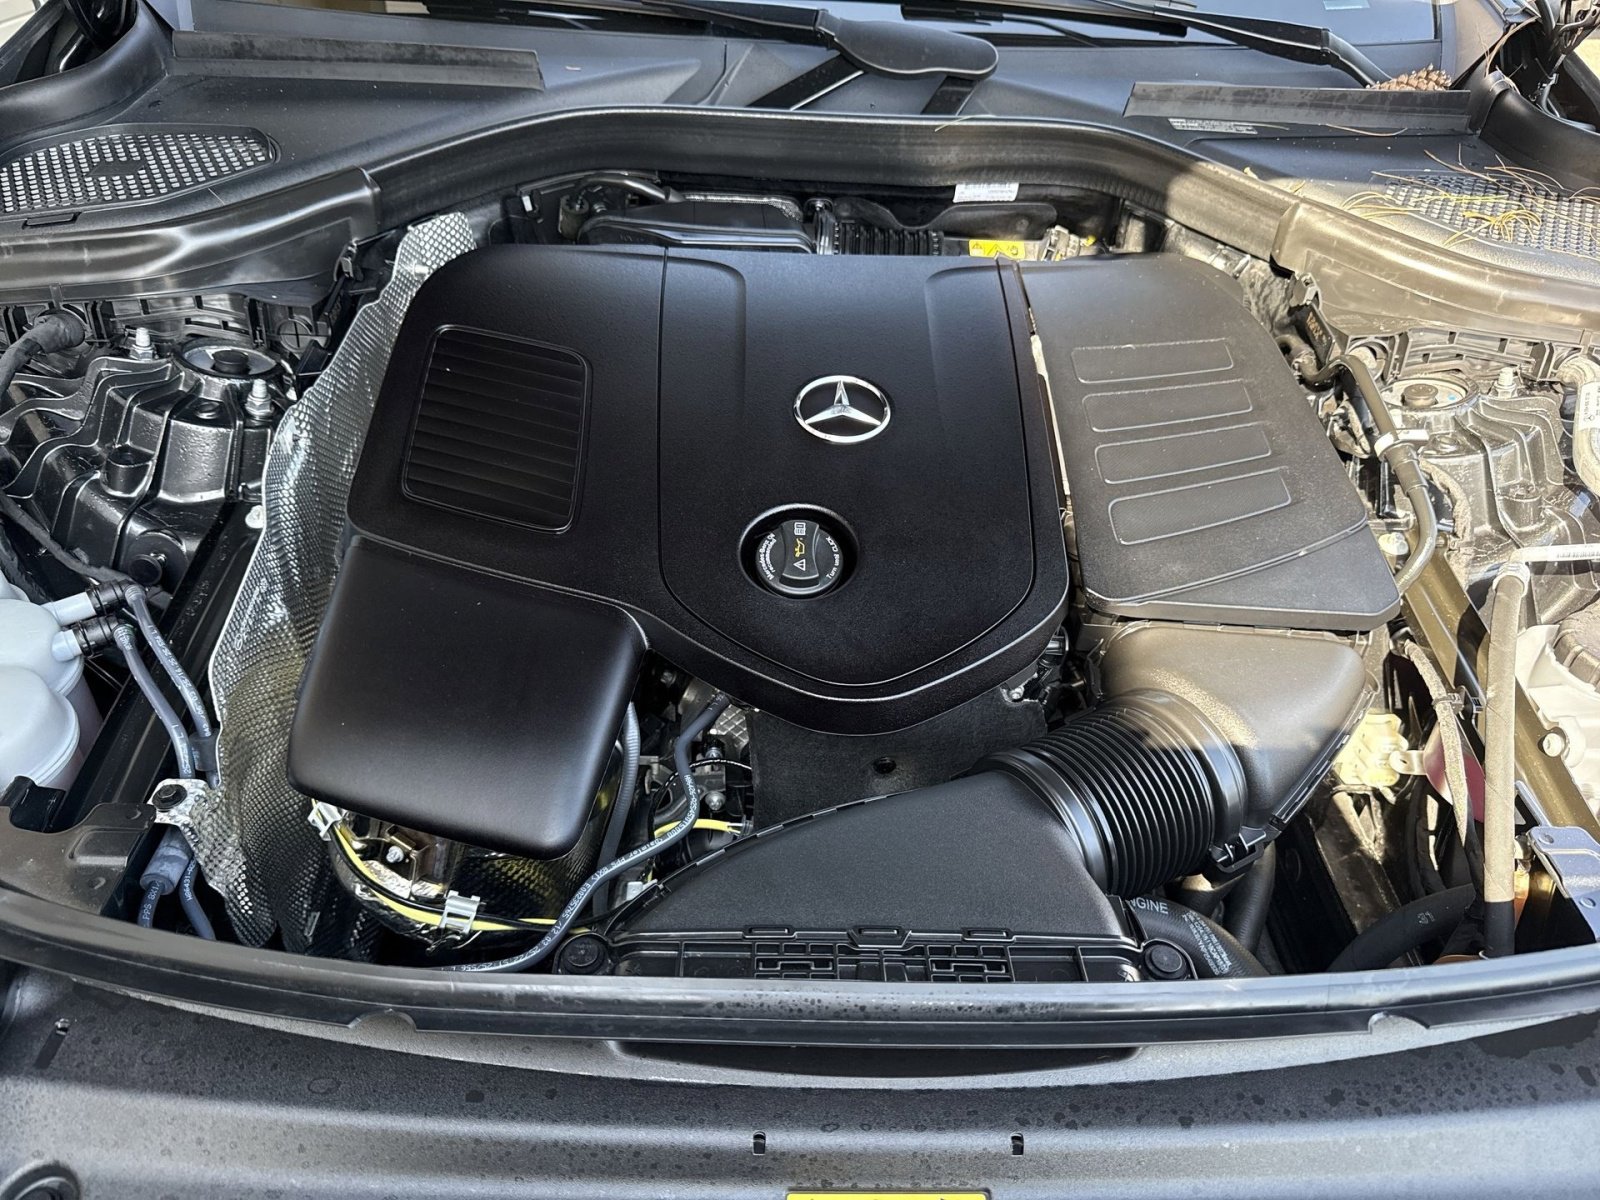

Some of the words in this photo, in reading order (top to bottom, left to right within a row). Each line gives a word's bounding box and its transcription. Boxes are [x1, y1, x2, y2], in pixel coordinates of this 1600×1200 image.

[825, 536, 839, 552] CLICK
[826, 567, 838, 579] Turn
[142, 904, 152, 920] PPS
